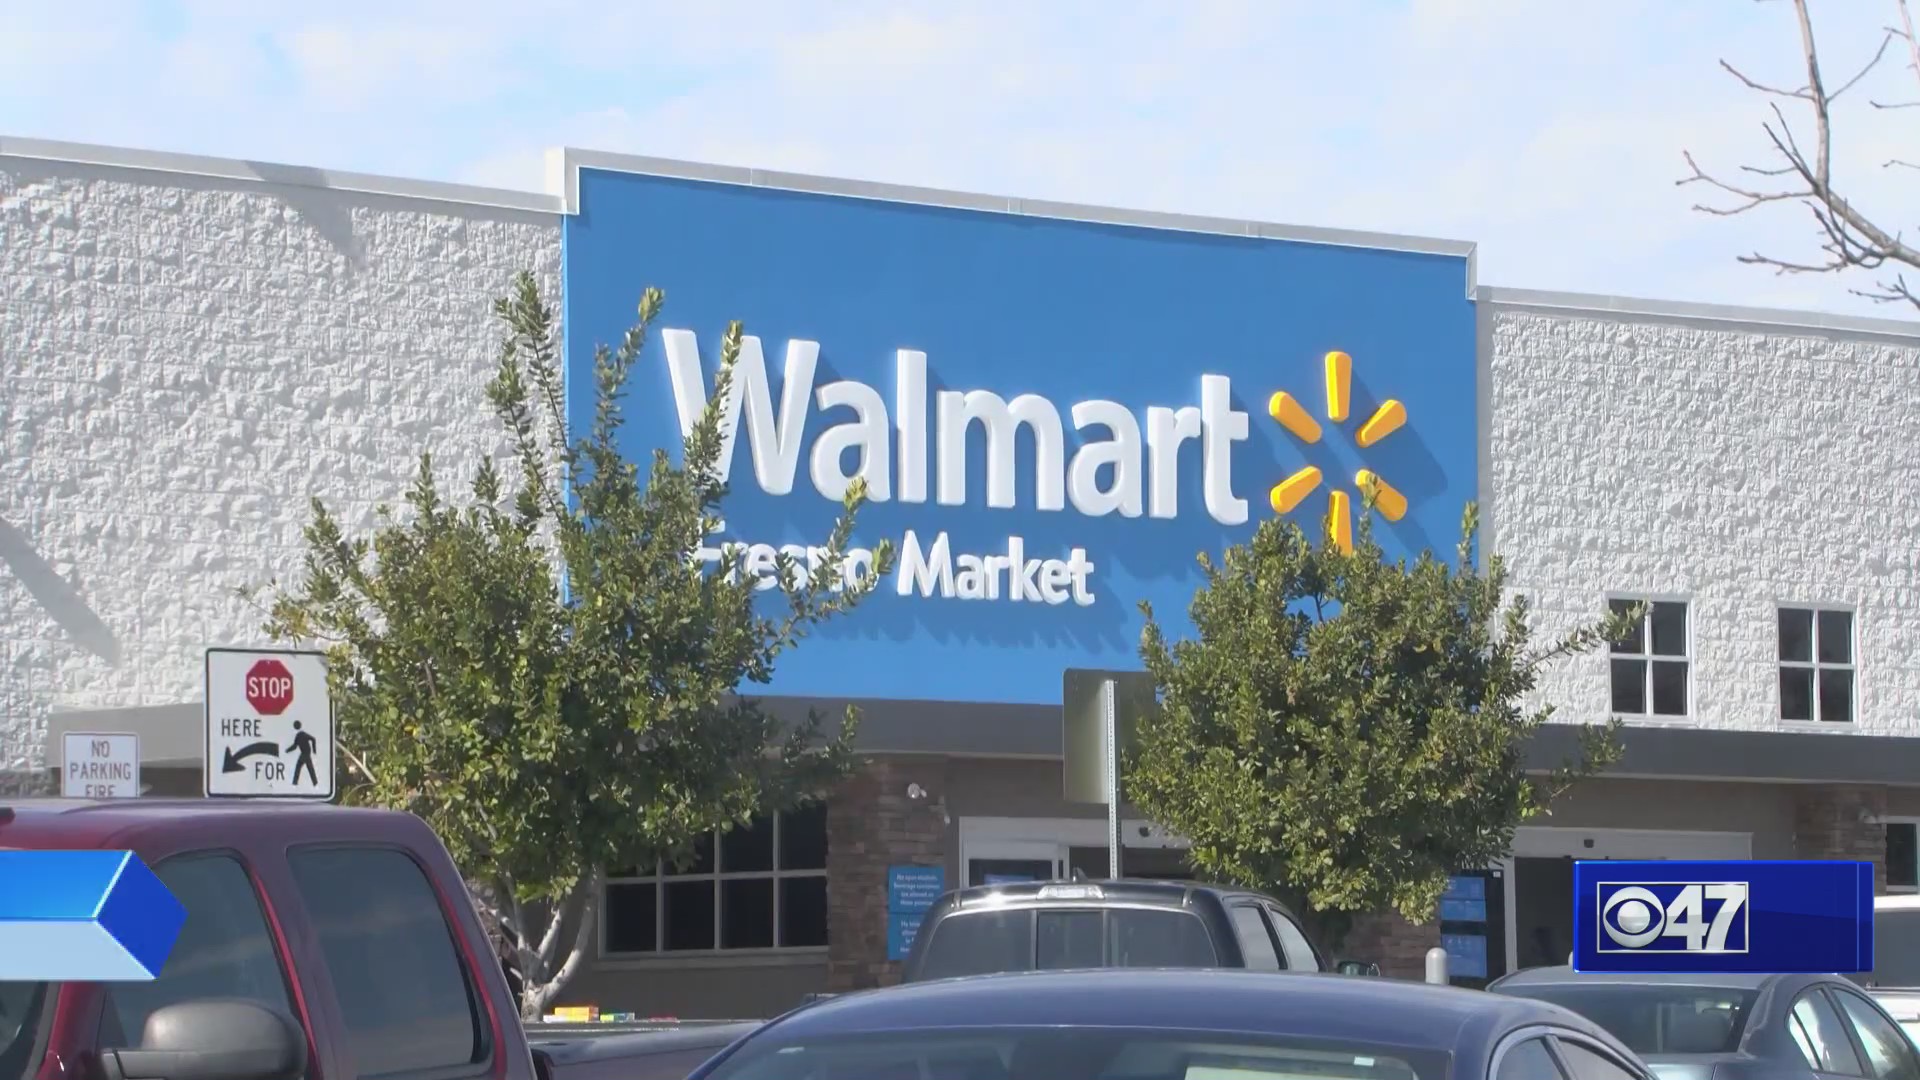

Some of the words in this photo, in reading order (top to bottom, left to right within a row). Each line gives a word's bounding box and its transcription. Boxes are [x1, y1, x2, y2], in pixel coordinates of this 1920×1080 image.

[662, 328, 1249, 525] Walmart
[898, 530, 1095, 606] Market
[248, 676, 292, 699] STOP
[222, 719, 262, 737] HERE
[91, 740, 110, 758] NO
[70, 761, 131, 780] PARKING
[255, 762, 285, 780] FOR
